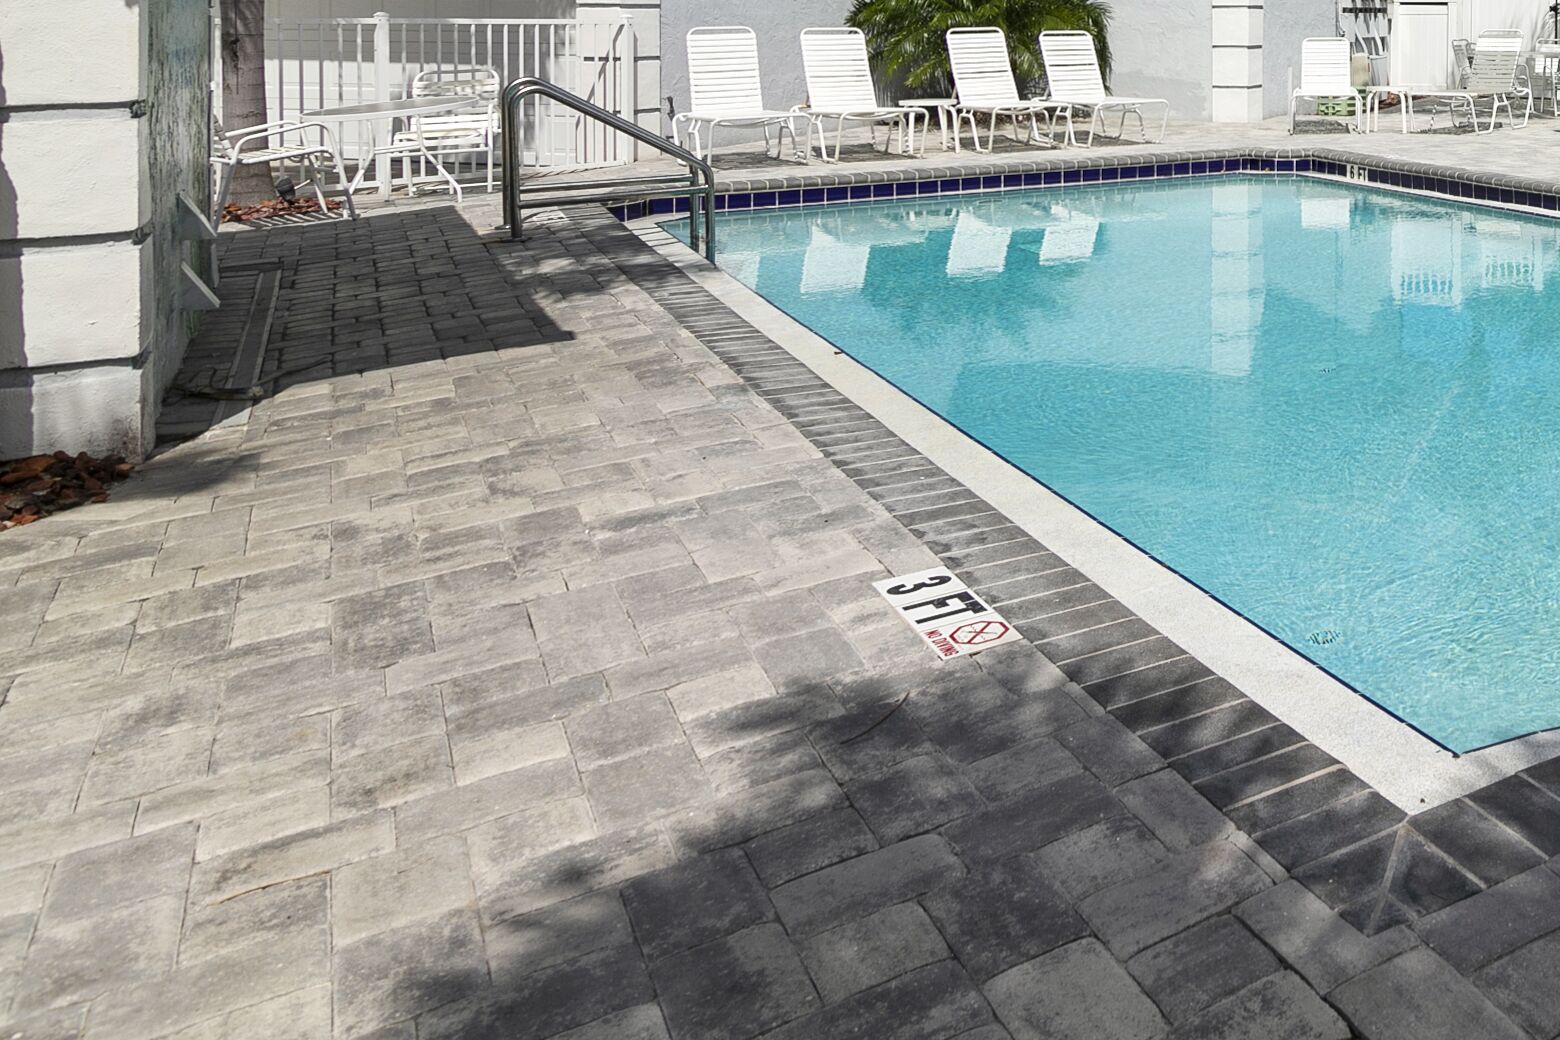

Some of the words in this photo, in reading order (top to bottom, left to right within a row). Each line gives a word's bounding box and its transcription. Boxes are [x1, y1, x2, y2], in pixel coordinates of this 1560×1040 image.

[1350, 165, 1355, 179] 6
[1358, 166, 1367, 181] FT
[886, 575, 952, 595] 3
[902, 590, 988, 624] FT
[923, 629, 943, 639] NO
[932, 637, 960, 657] DIVING
